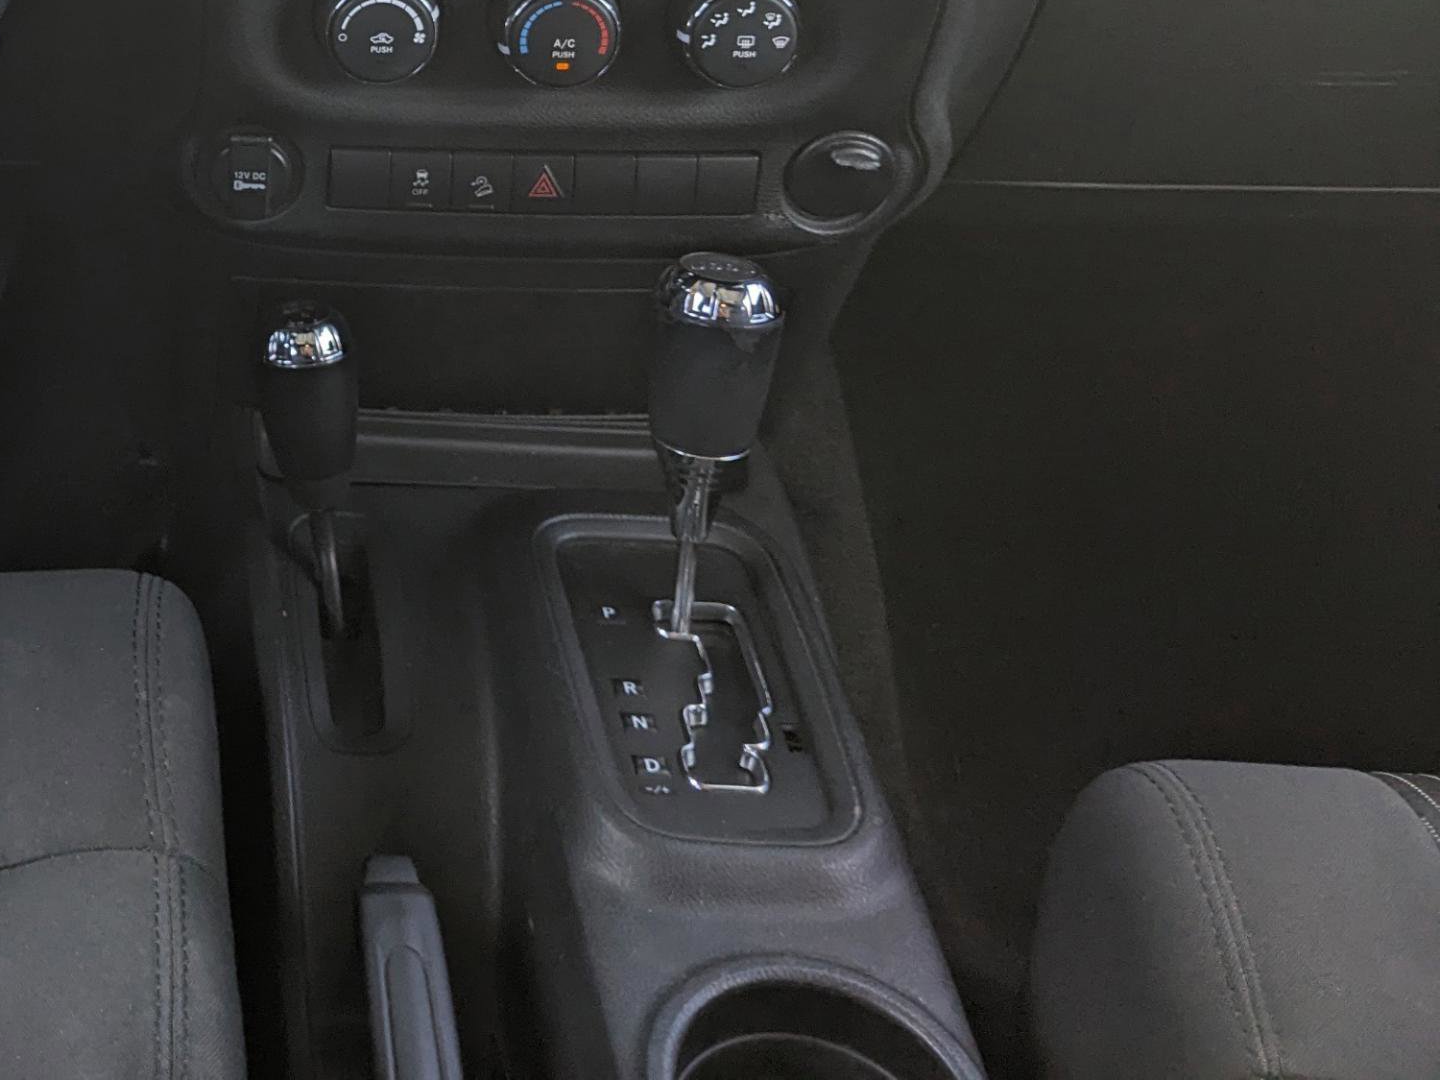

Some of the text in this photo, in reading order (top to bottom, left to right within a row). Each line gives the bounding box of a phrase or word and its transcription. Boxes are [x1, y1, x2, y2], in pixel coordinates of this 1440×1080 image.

[553, 38, 576, 49] A/C
[370, 45, 393, 54] PUSH
[732, 50, 757, 58] PUSH
[552, 51, 575, 59] PUSH
[234, 171, 266, 181] 12V DC
[411, 188, 429, 196] OFF
[601, 607, 616, 619] P
[622, 681, 637, 695] R
[631, 716, 648, 730] N
[643, 758, 661, 773] D
